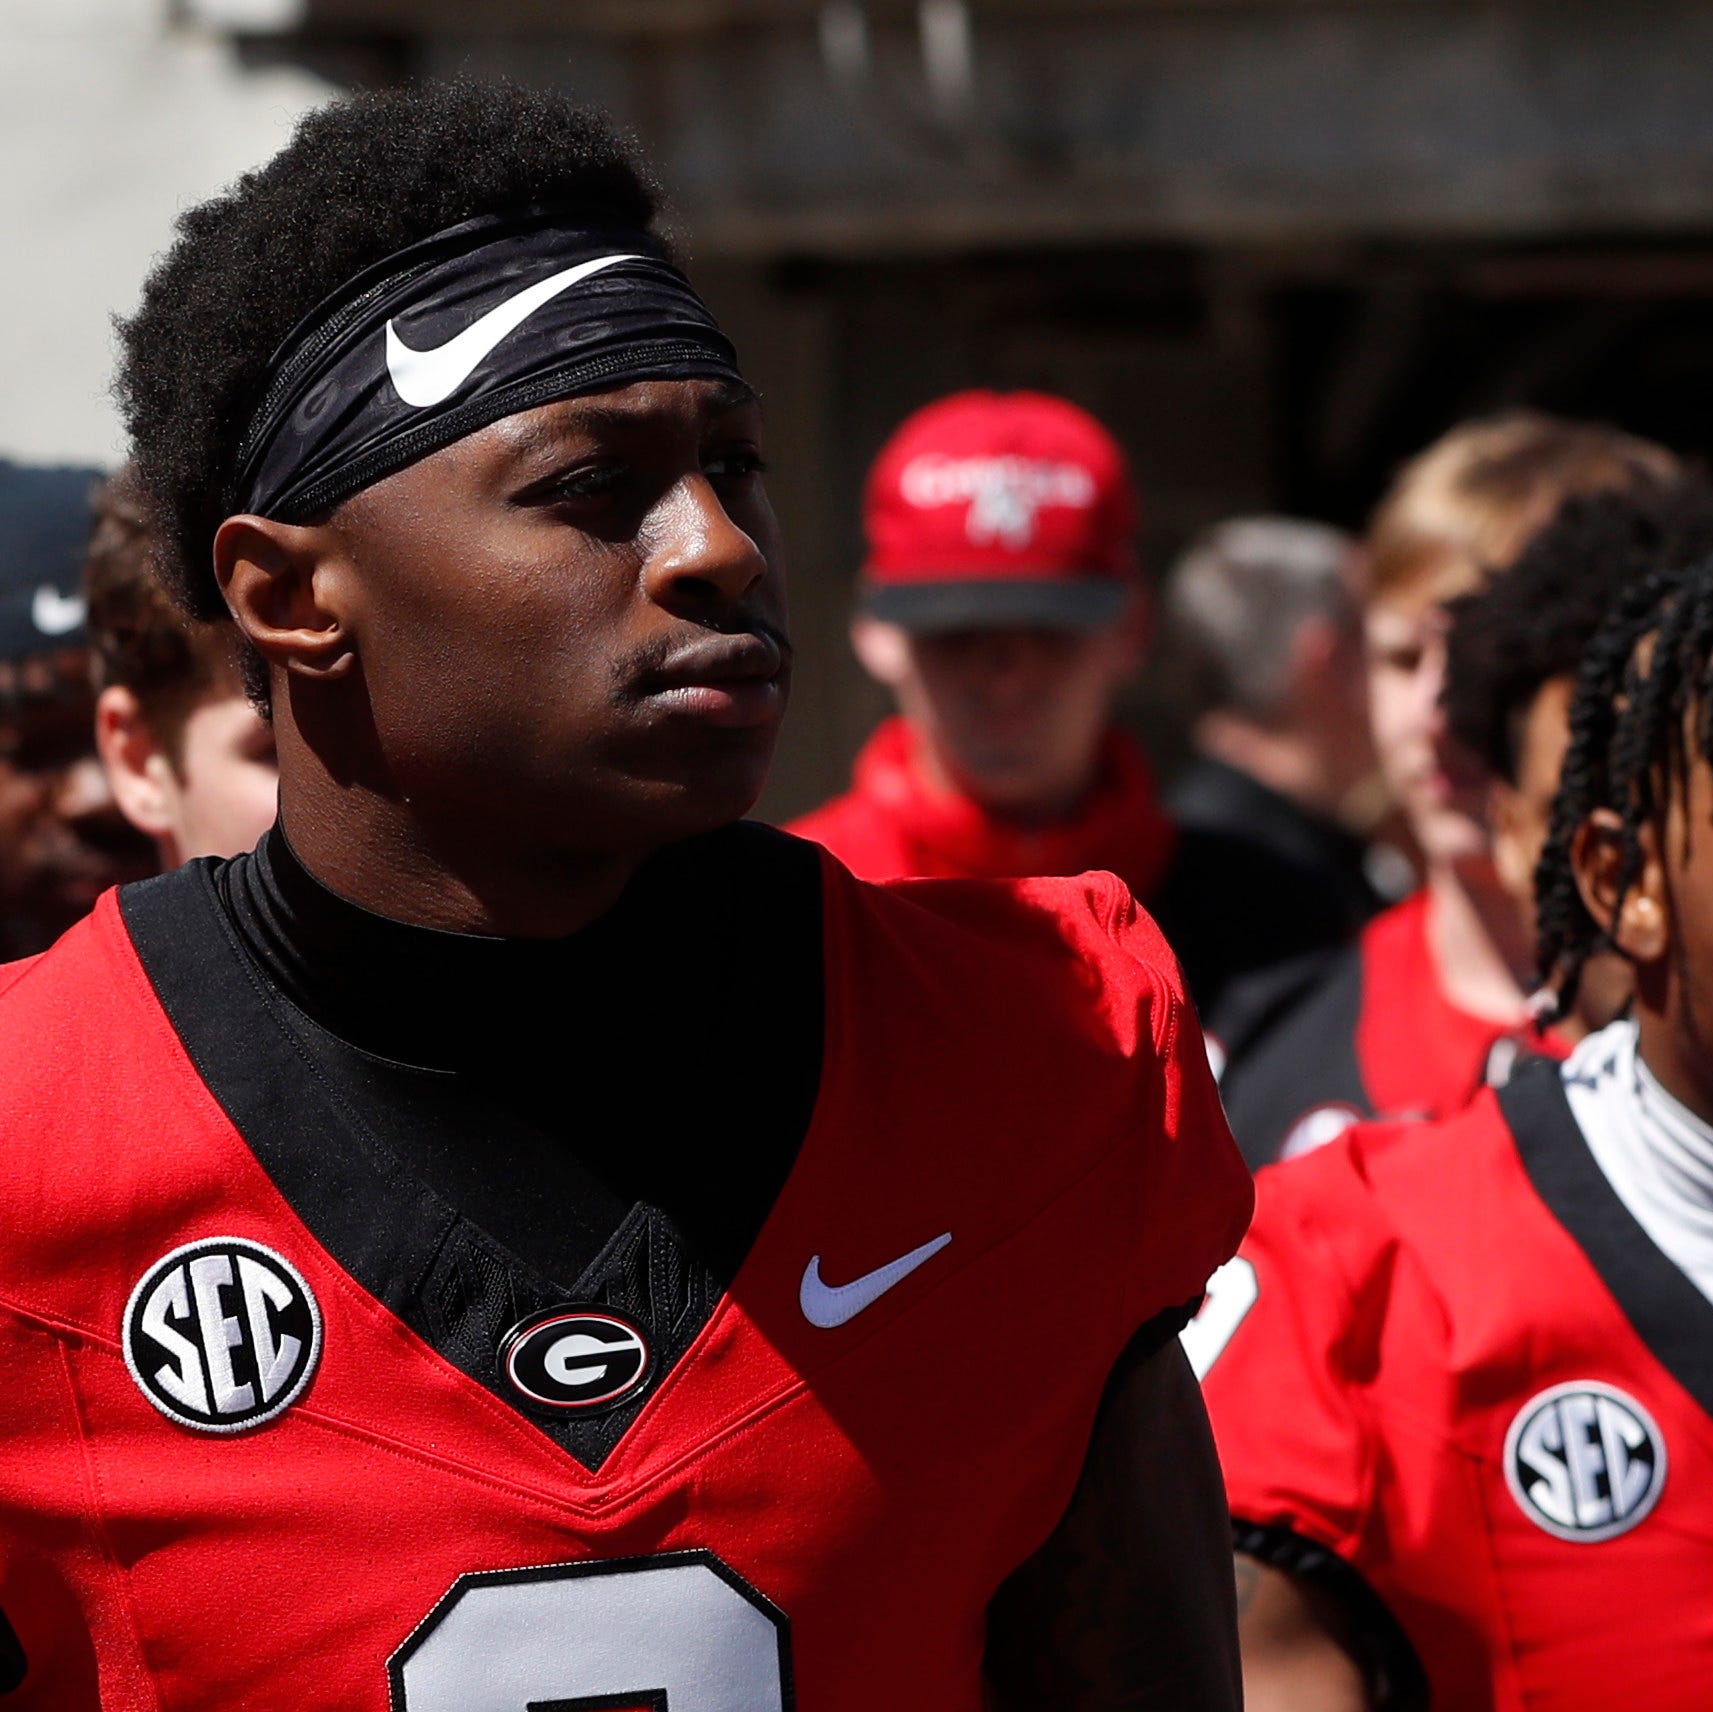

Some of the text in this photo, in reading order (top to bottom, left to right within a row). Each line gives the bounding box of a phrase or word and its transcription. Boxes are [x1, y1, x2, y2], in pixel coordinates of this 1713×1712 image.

[141, 1254, 302, 1416] SEC
[513, 1318, 642, 1403] G
[1519, 1394, 1652, 1528] SEC
